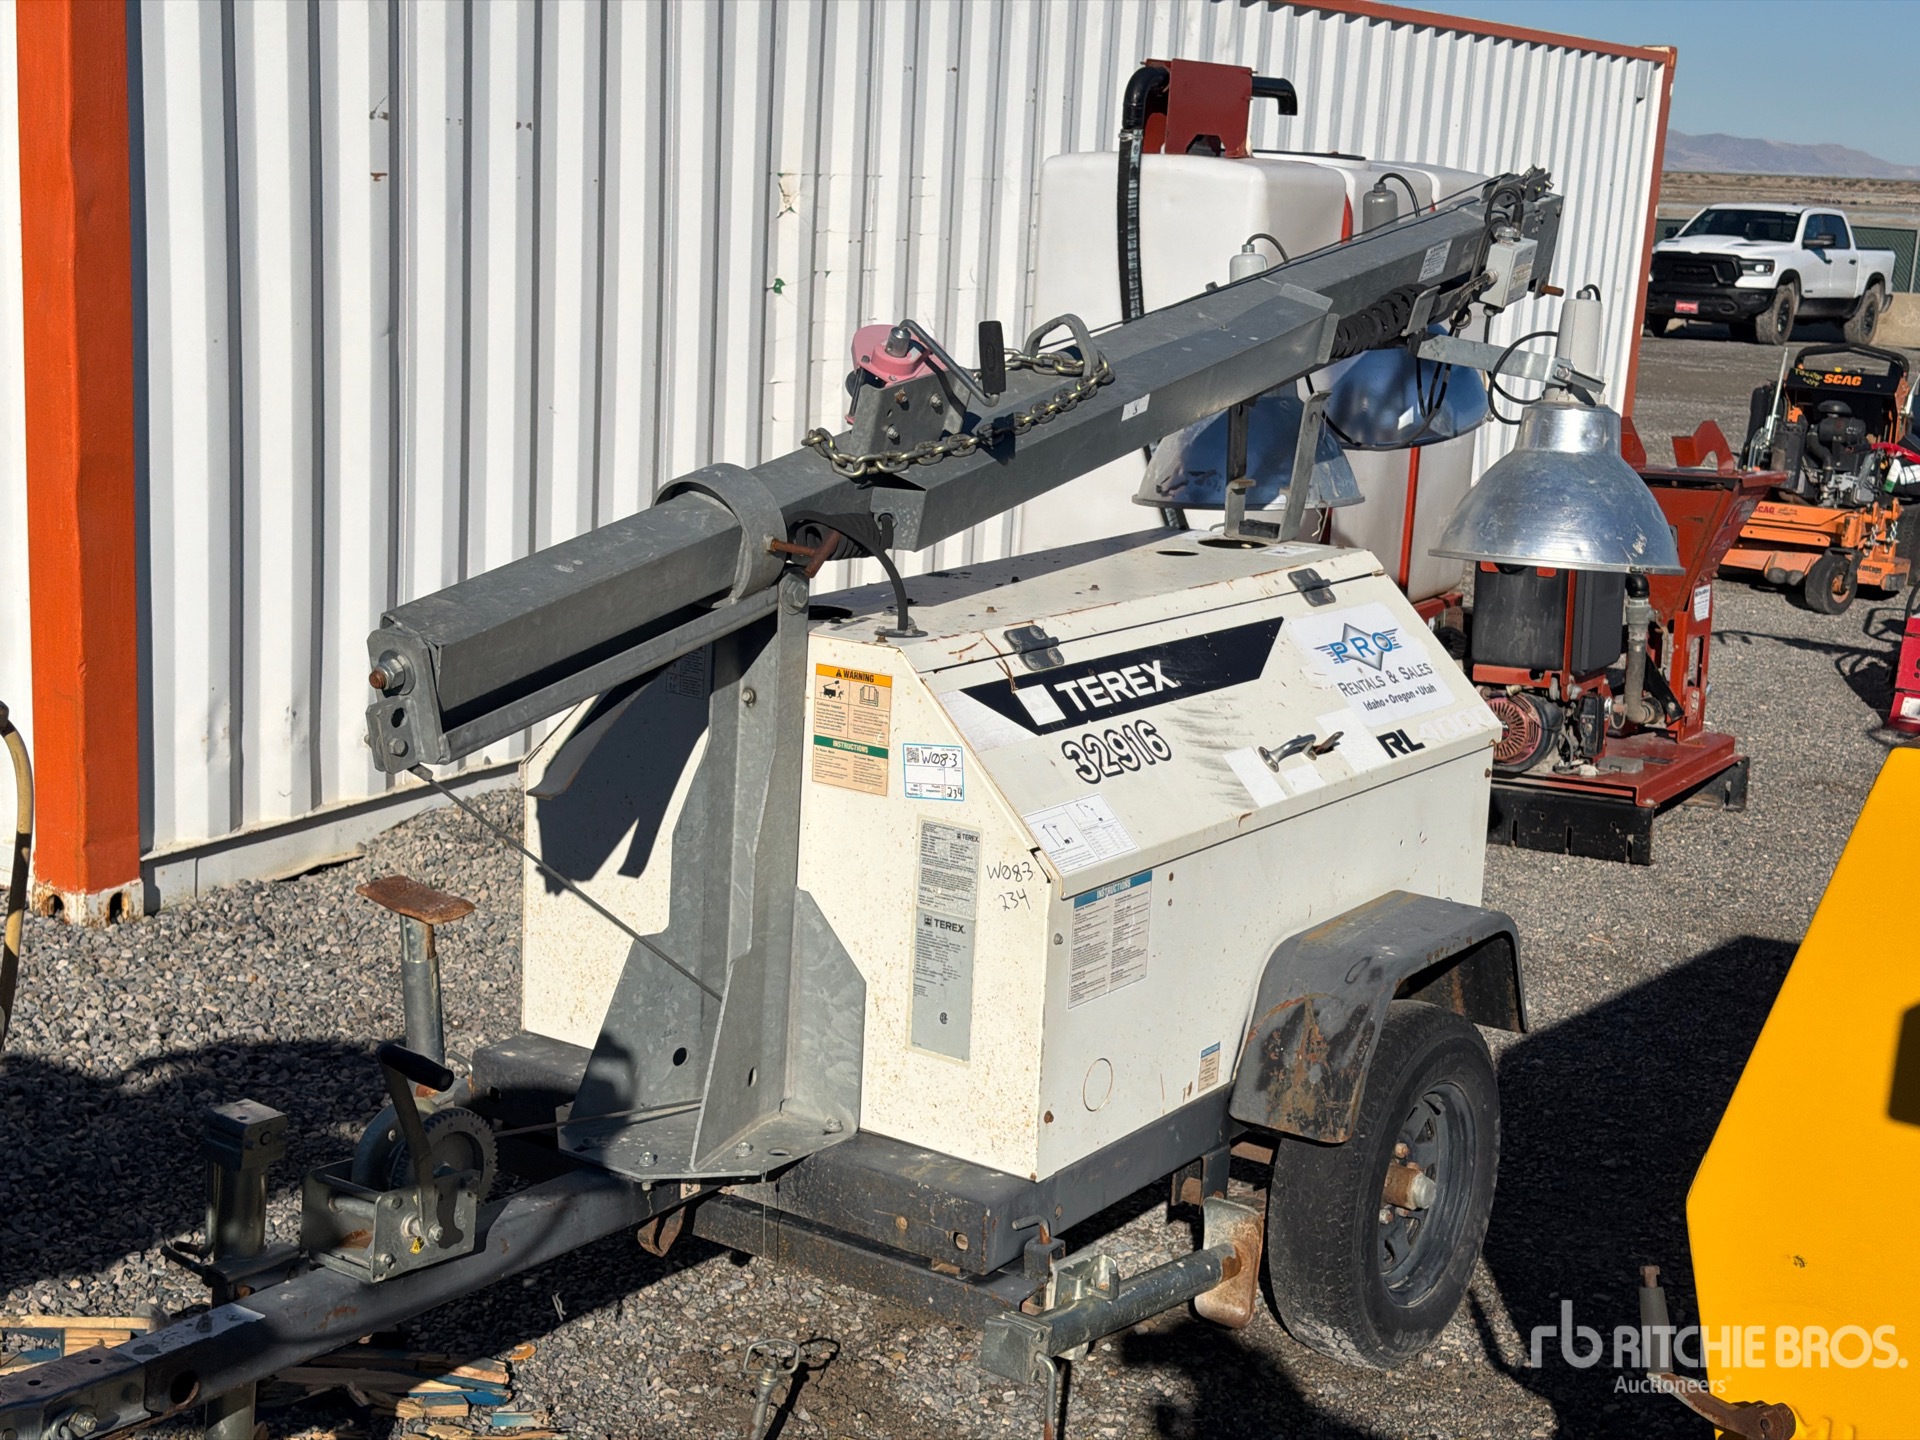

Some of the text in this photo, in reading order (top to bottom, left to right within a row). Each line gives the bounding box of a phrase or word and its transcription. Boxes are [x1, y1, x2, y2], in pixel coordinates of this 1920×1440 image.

[1823, 373, 1862, 386] SCAG
[1755, 505, 1775, 514] CAG
[1328, 632, 1393, 664] PRO
[843, 669, 875, 683] WARNING
[1337, 663, 1433, 697] RENTALS & SALES
[1054, 659, 1178, 712] TEREX
[1363, 683, 1437, 711] Idaho Oregon Utah
[832, 739, 868, 754] INSTRUCTIONS
[1061, 719, 1172, 784] 32916
[947, 786, 962, 799] 234
[962, 833, 979, 842] TEREX
[998, 888, 1031, 911] 234
[934, 918, 964, 934] TEREX
